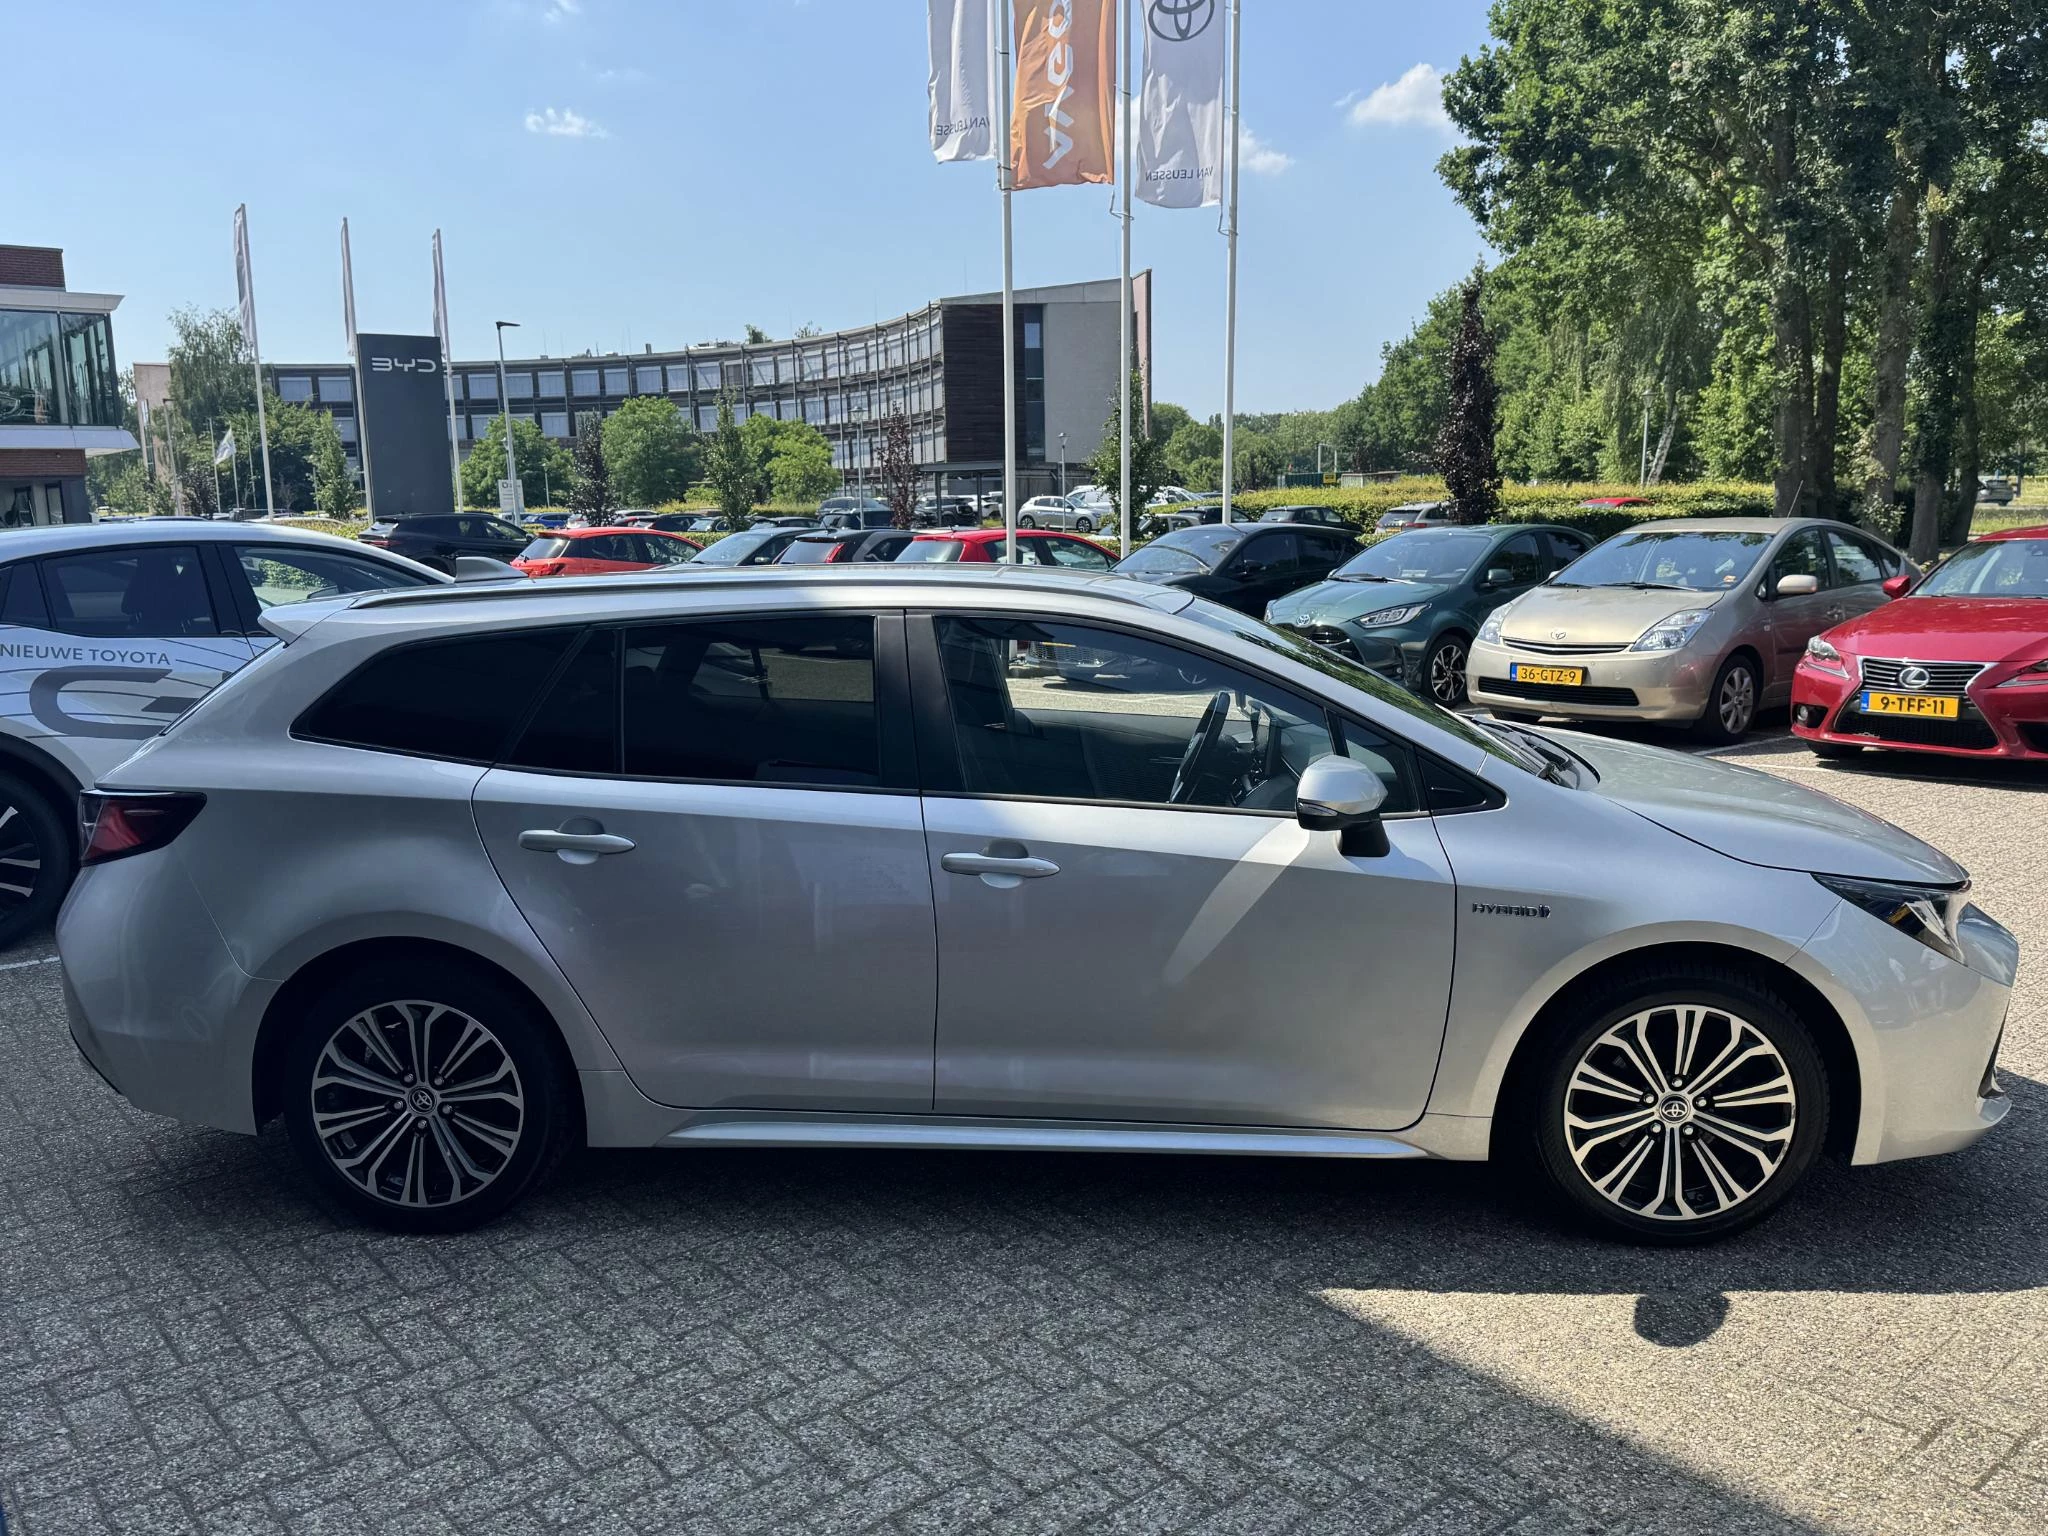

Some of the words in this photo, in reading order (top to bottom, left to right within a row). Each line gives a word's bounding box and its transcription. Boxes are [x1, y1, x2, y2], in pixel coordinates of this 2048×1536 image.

[371, 357, 436, 373] BYD
[0, 643, 83, 661] NIEUWE
[88, 648, 172, 666] TOYOTA
[1521, 667, 1577, 683] 36-GTZ-9
[1880, 696, 1945, 715] 9-TFF-11
[1472, 902, 1538, 918] HYBRID
